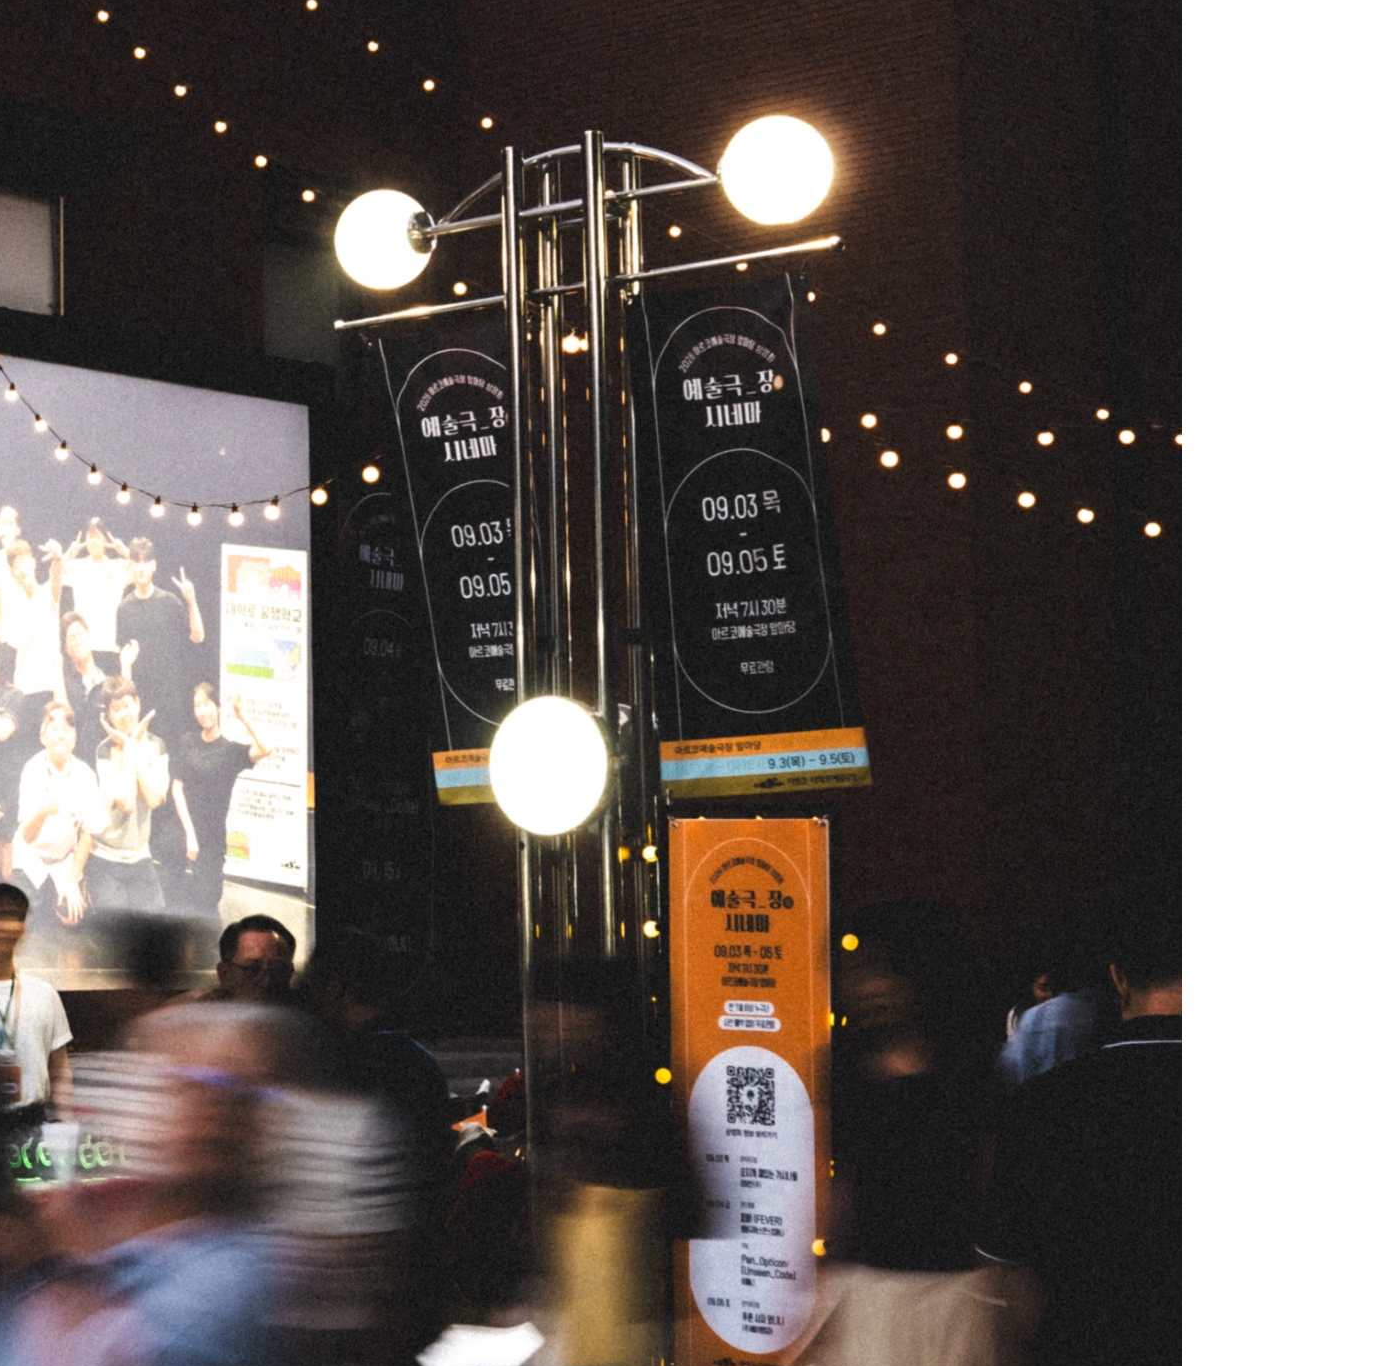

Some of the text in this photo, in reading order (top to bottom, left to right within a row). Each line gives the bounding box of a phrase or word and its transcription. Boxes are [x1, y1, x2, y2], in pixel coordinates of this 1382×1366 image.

[705, 400, 762, 428] 시네마
[444, 435, 497, 462] 시네마
[702, 489, 781, 522] 09.03 목
[451, 520, 504, 548] 09.03
[707, 543, 787, 577] 09.05 토
[459, 572, 512, 599] 09.05
[715, 597, 787, 619] 저녁 7시 30분
[711, 623, 768, 641] 아르코예술극장
[767, 755, 806, 770] 9.3(목)
[818, 751, 855, 766] 9.5(토)
[725, 913, 771, 934] 시네마
